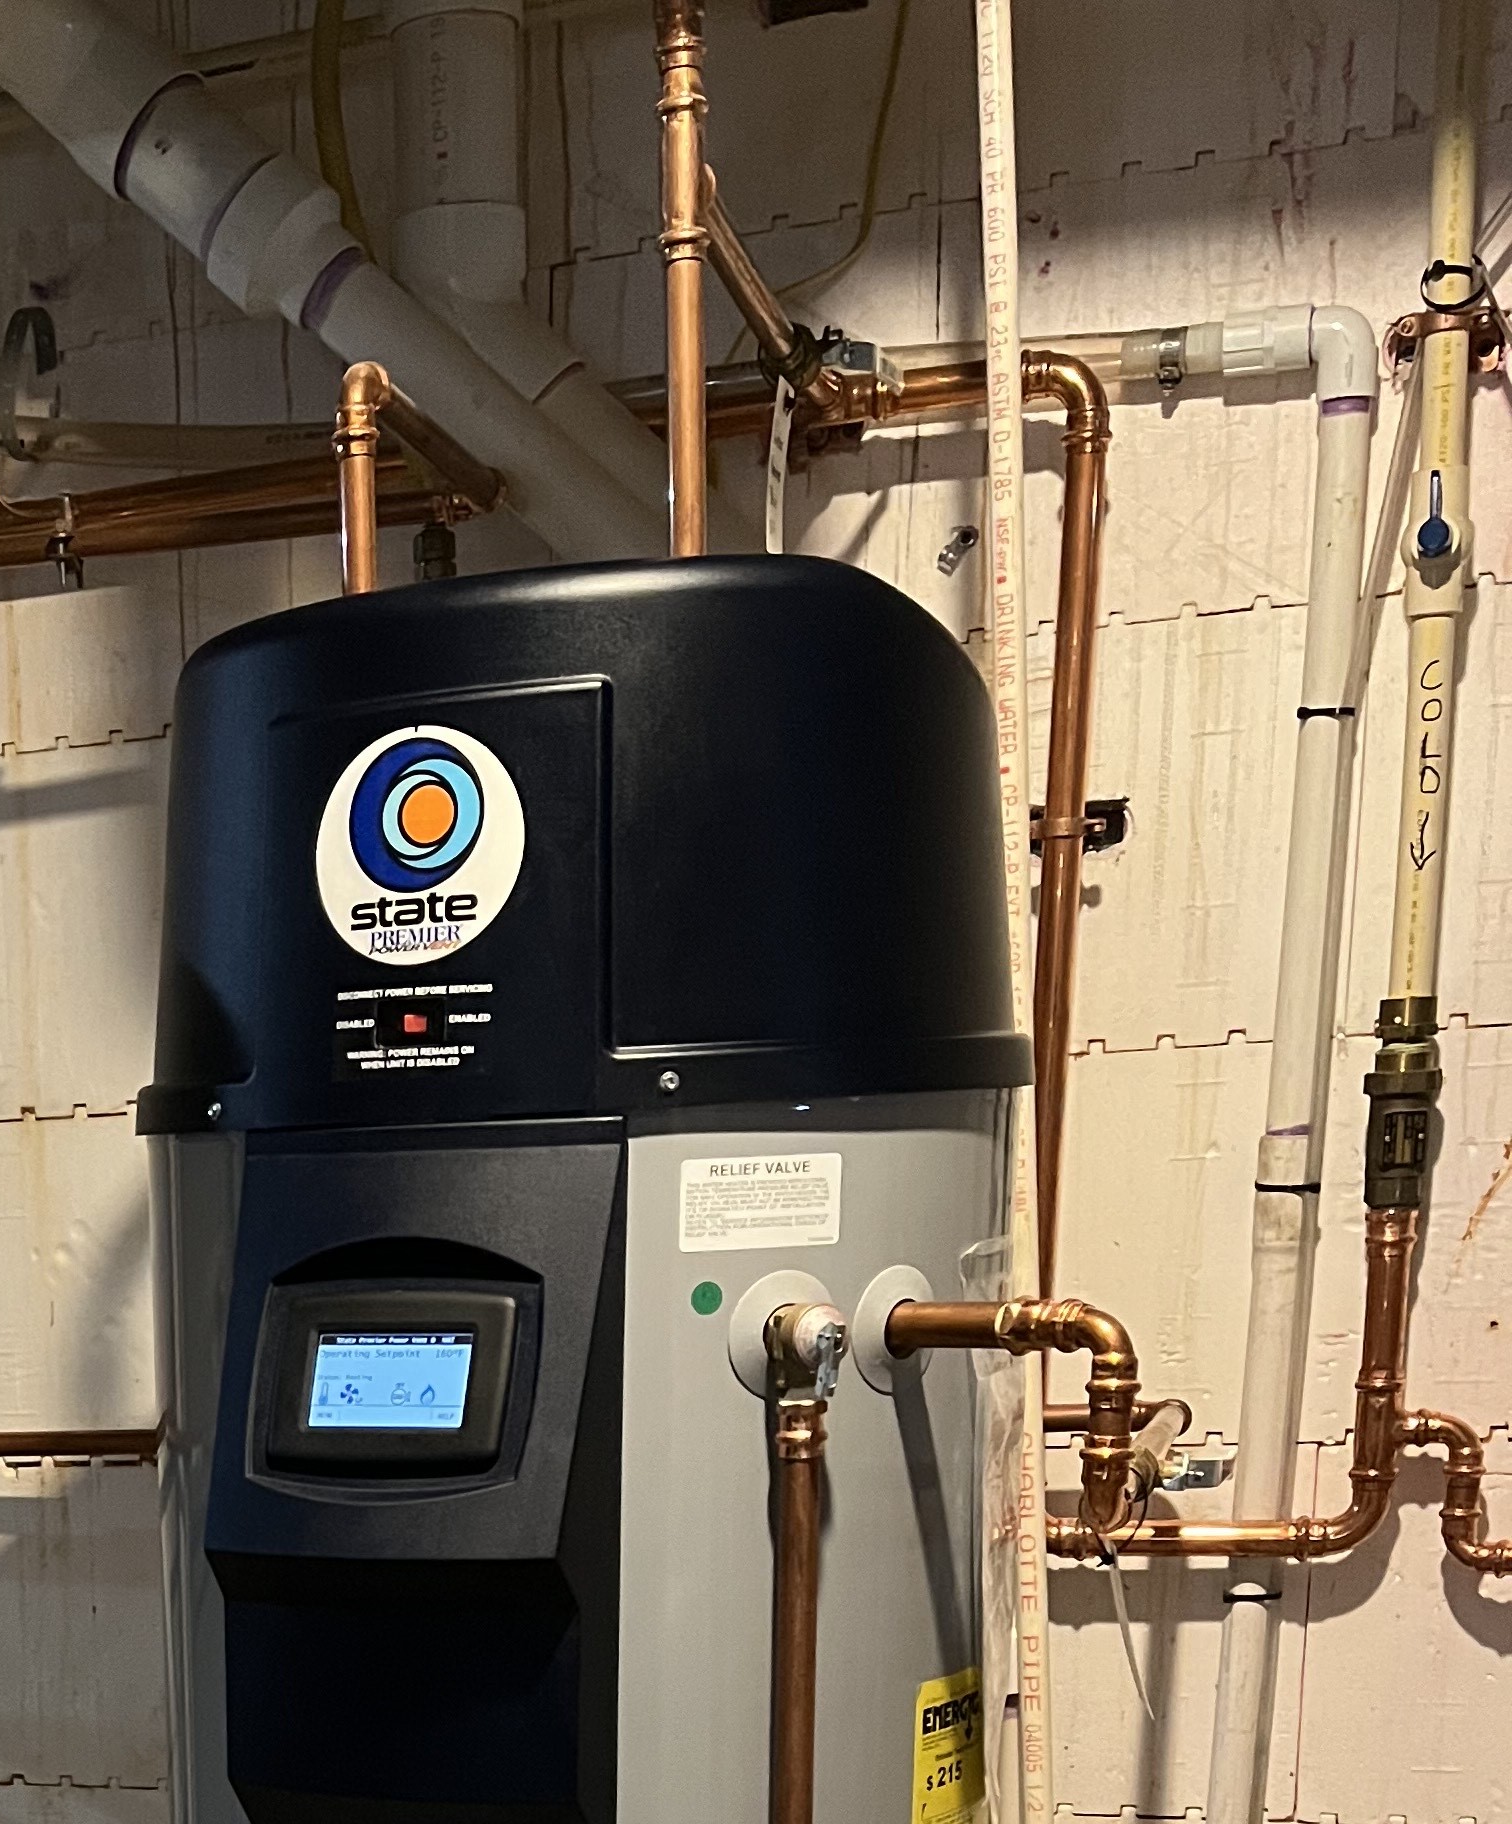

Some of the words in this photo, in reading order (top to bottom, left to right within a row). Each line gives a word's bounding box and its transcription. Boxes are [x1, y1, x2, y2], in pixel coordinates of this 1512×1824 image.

[993, 372, 1010, 421] ASTM
[993, 429, 1013, 502] D-1785
[996, 593, 1017, 688] DRINKING
[999, 698, 1019, 757] WATER
[350, 892, 479, 931] state
[370, 924, 462, 948] PREMIER
[709, 1162, 761, 1177] RELIEF
[765, 1160, 811, 1175] VALVE
[1019, 1431, 1038, 1613] CHARLOTTE
[1022, 1634, 1041, 1712] PIPE
[1024, 1723, 1043, 1773] 04005
[936, 1760, 963, 1788] 215
